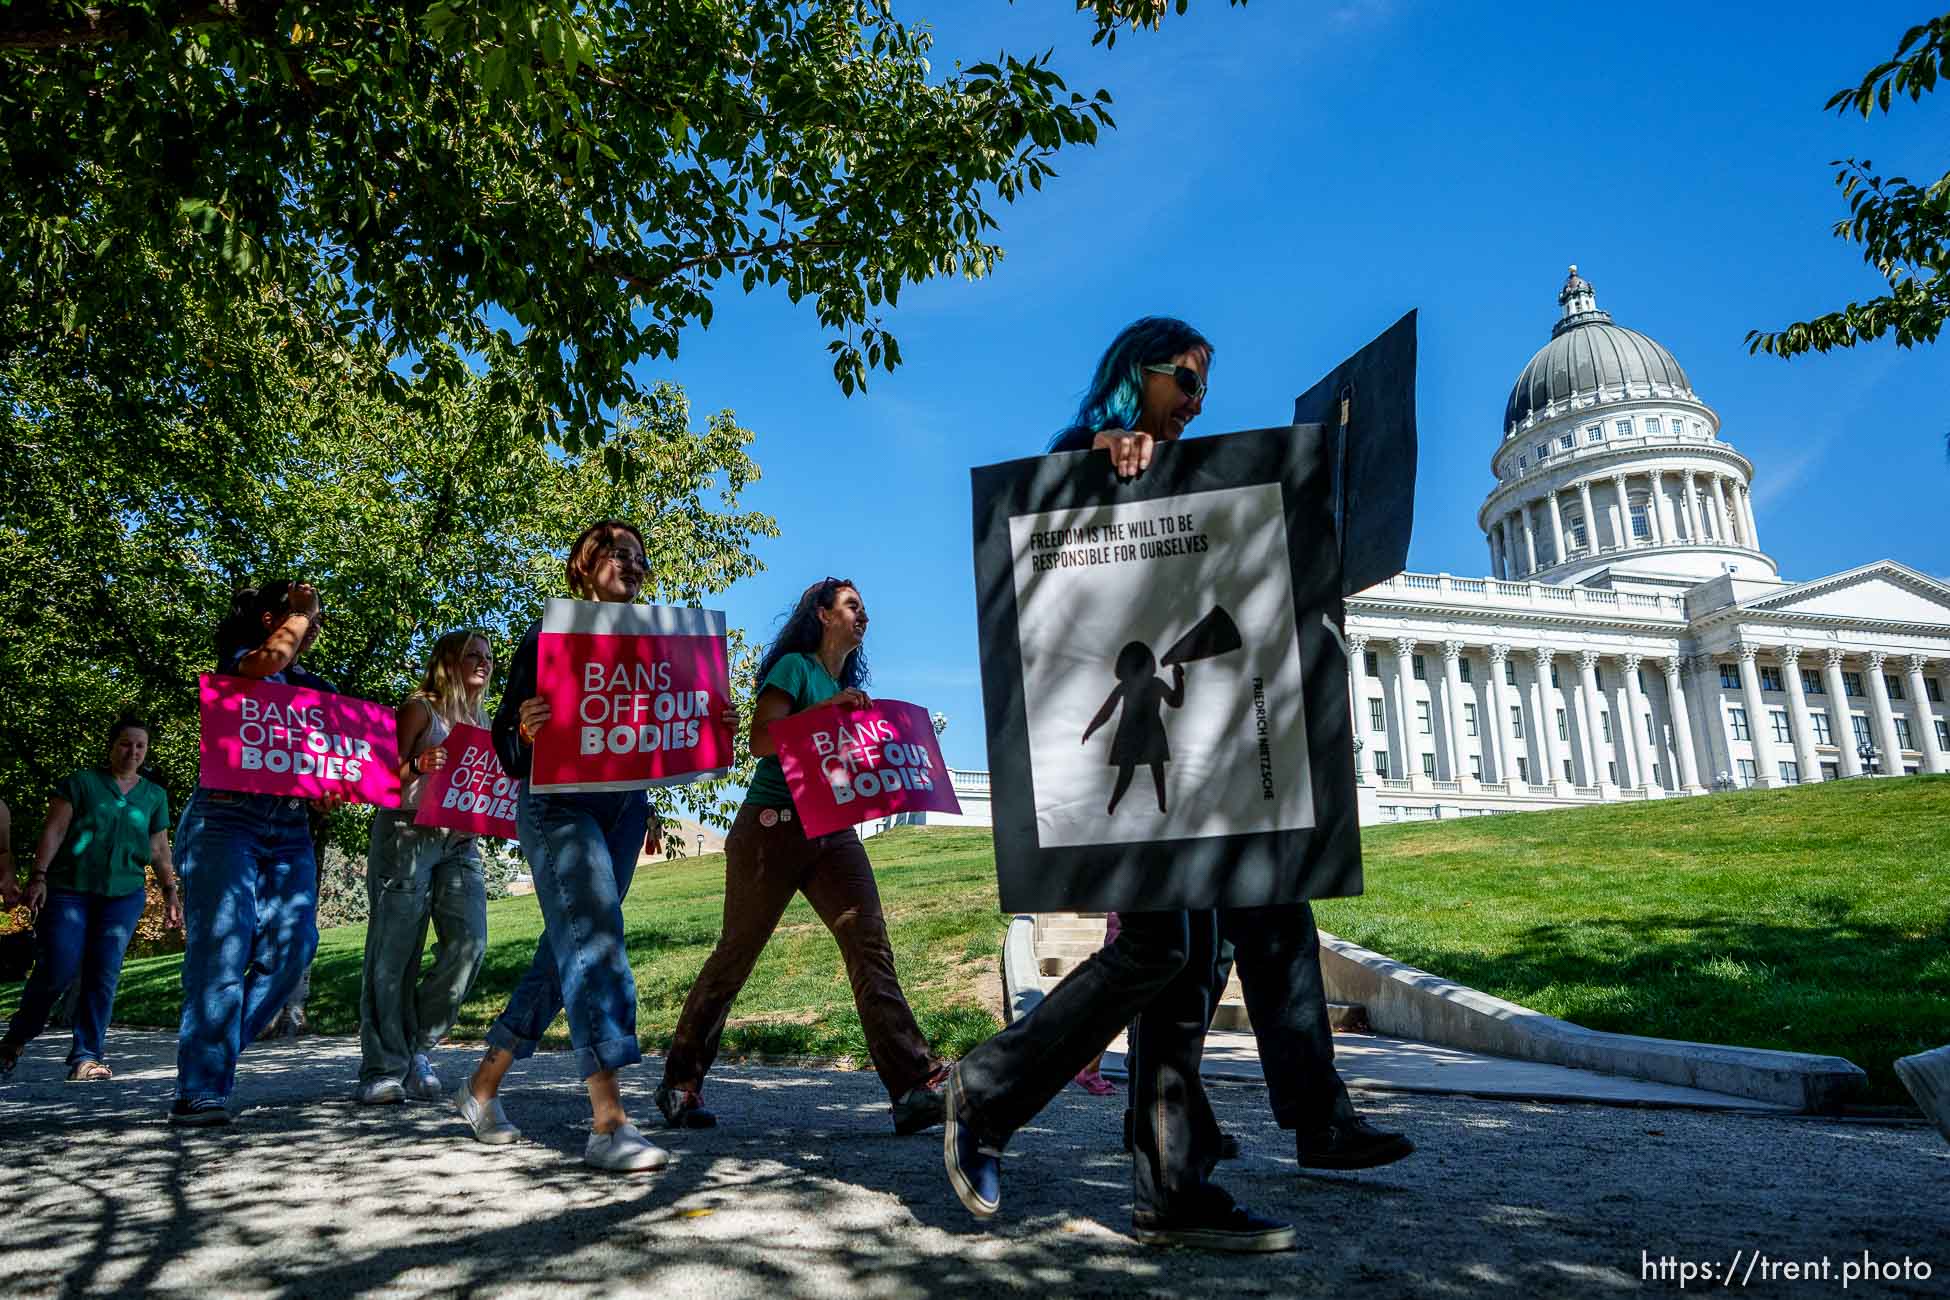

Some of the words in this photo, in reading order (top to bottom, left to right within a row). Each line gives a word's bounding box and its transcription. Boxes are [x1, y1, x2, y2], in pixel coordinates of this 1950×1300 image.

[1030, 527, 1084, 551] FREEDOM
[1088, 526, 1099, 543] IS
[1103, 523, 1125, 541] THE
[1128, 519, 1157, 539] WILL
[1159, 516, 1175, 535] TO
[1178, 514, 1194, 532] BE
[1032, 547, 1111, 572] RESPONSIBLE
[1114, 544, 1137, 562] FOR
[1140, 533, 1209, 560] OURSELVES
[584, 662, 671, 692] BANS
[241, 697, 326, 730] BANS
[580, 694, 650, 724] OFF
[654, 690, 710, 721] OUR
[1253, 677, 1268, 736] FRIEDRICH
[240, 722, 303, 749] OFF
[307, 731, 373, 762] OUR
[580, 719, 700, 755] BODIES
[812, 719, 895, 756] BANS
[241, 746, 363, 782] BODIES
[460, 745, 506, 776] BAN
[821, 745, 881, 780] OFF
[884, 743, 933, 768] OUR
[451, 767, 496, 792] OFF
[831, 767, 934, 805] BODIES
[442, 787, 518, 820] BODIES
